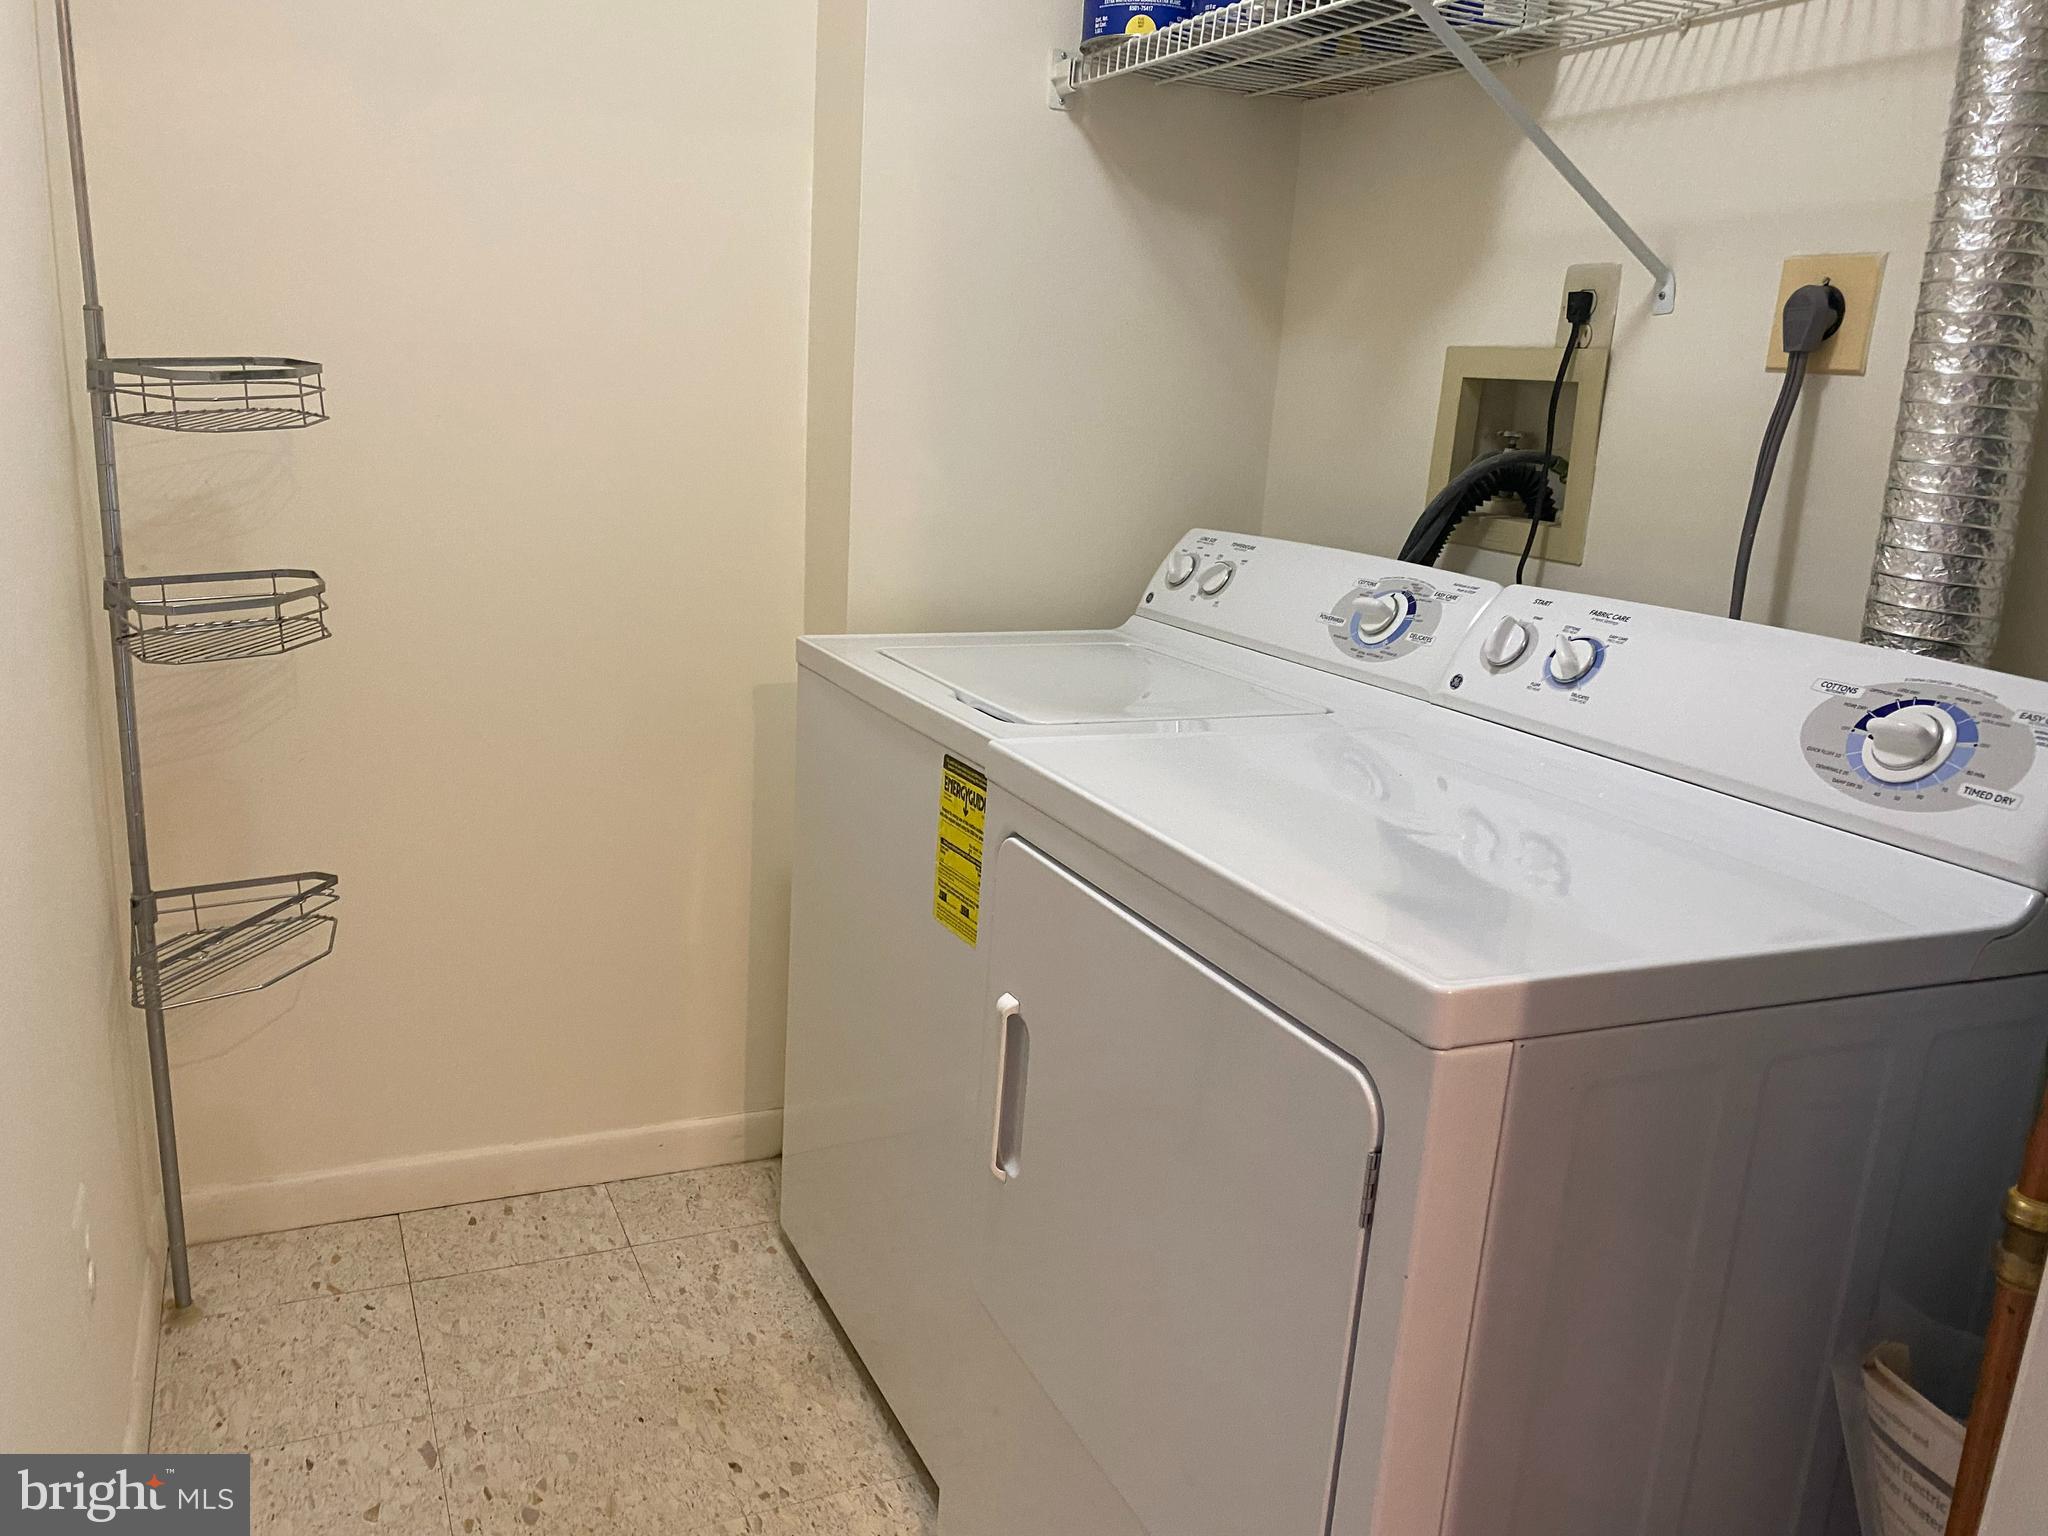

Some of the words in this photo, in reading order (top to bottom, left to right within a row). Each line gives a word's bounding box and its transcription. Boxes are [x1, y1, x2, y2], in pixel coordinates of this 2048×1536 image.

[1533, 599, 1553, 607] START
[1589, 609, 1613, 619] FABRIC
[1612, 614, 1632, 623] CARE
[1409, 633, 1433, 643] DELICATES
[1821, 681, 1859, 694] COTTONS
[2019, 712, 2046, 722] EASY
[1963, 786, 1994, 800] TIMED
[1994, 794, 2016, 806] DRY
